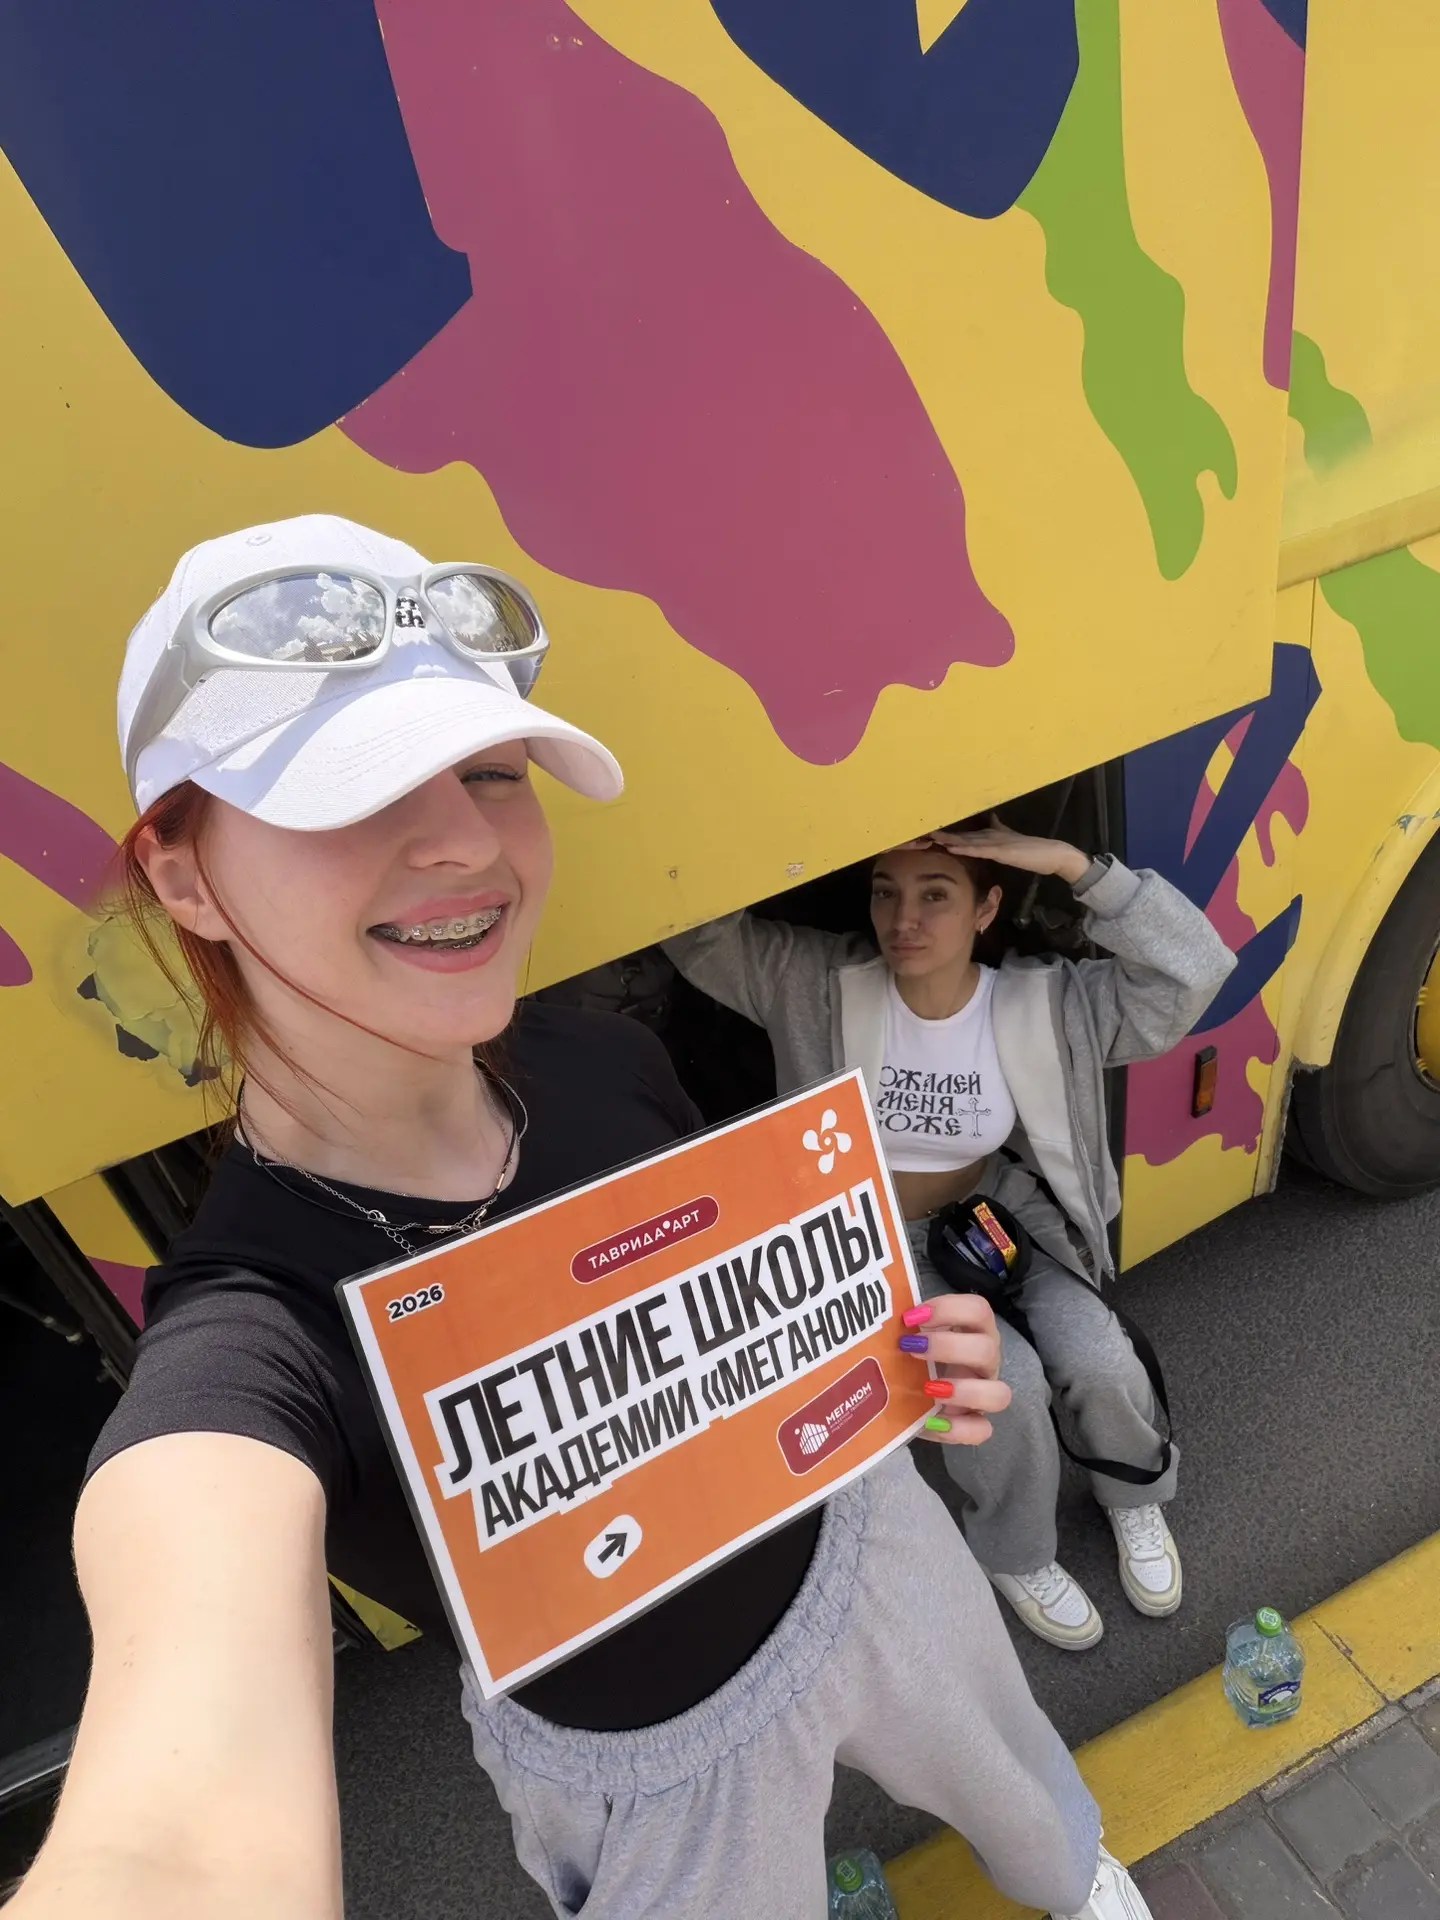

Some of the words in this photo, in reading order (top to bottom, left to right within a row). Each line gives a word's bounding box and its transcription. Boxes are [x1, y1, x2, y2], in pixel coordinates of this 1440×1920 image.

[879, 1065, 982, 1095] ОЖАЛЕЙ
[877, 1090, 954, 1115] МЕНЯ
[388, 1285, 443, 1320] 2026
[439, 1293, 684, 1485] ЛЕТНИЕ
[680, 1191, 885, 1356] ШКОЛЫ
[481, 1378, 700, 1538] АКАДЕМИИ
[701, 1279, 888, 1411] «МЕГАНОМ»
[825, 1381, 873, 1425] МЕГАНОМ
